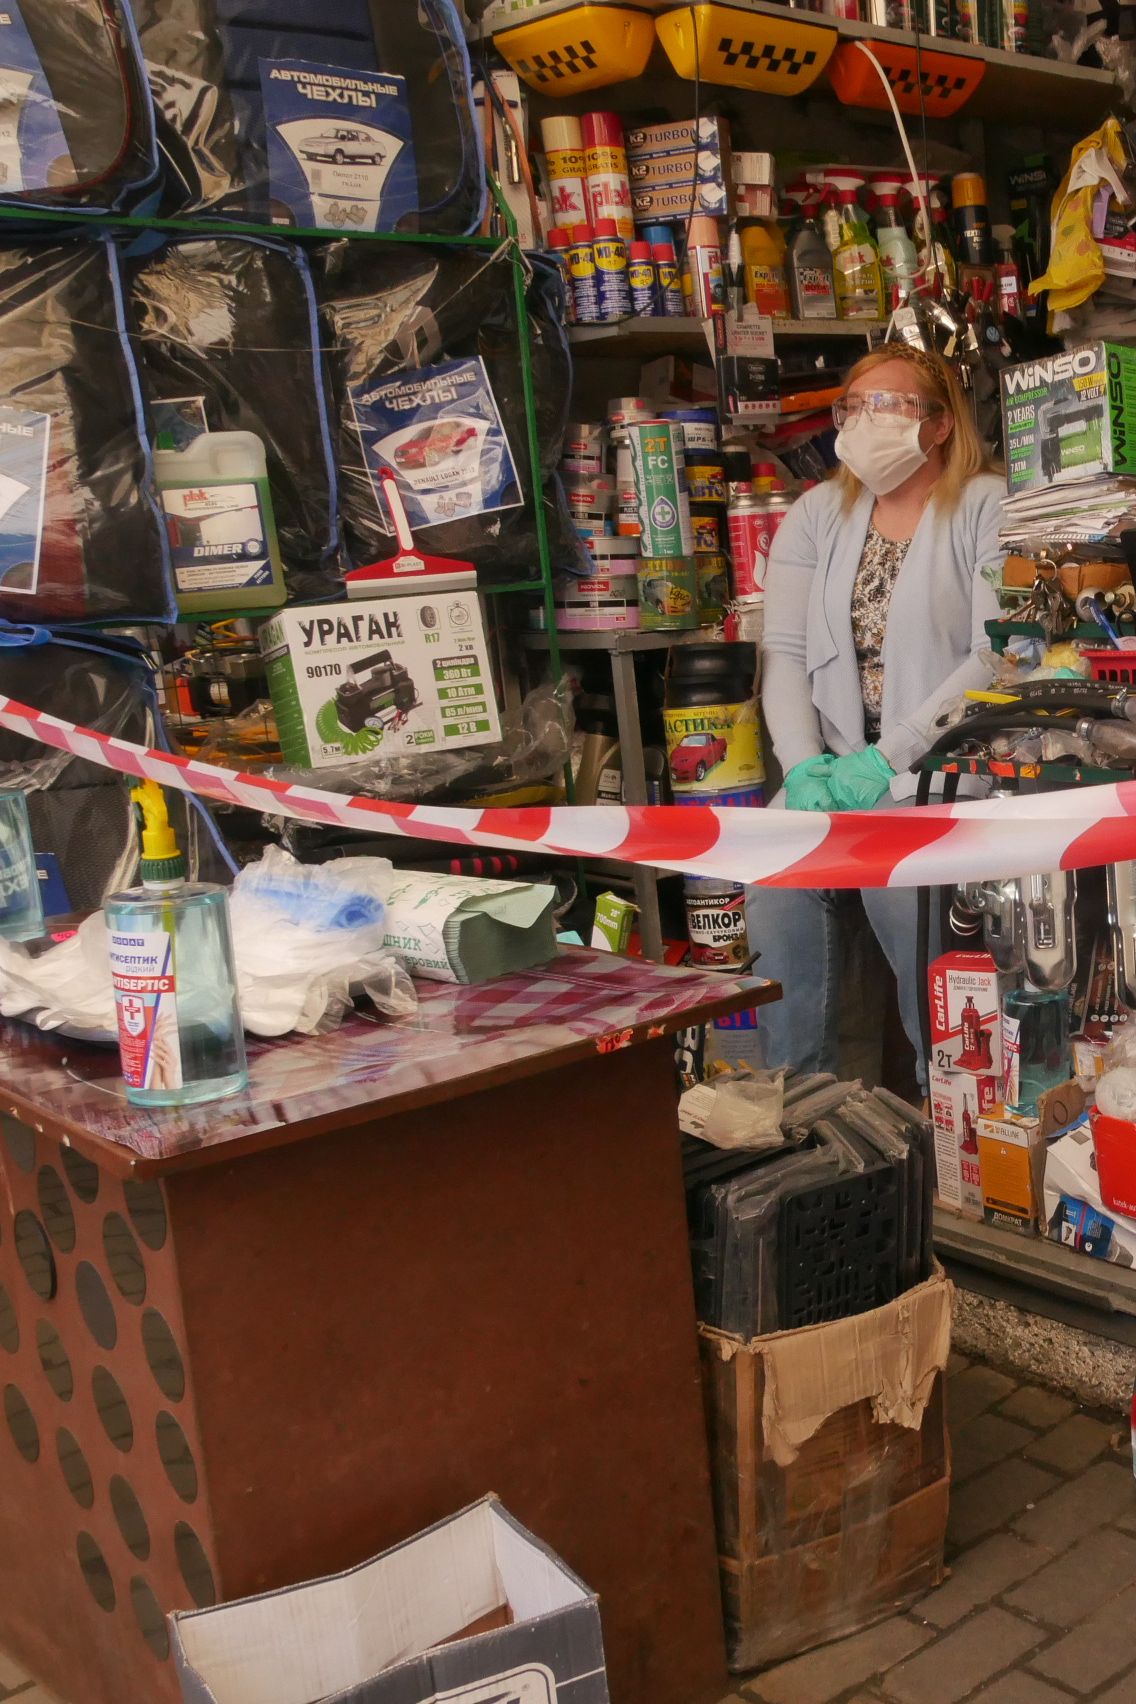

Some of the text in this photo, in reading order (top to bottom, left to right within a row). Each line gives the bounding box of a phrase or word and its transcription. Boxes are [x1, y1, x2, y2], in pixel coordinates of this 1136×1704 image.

[269, 68, 399, 97] АВТОМОБИЛЬНЫЕ
[296, 83, 377, 108] ЧЕХЛЫ
[629, 128, 688, 145] K2 TURBO
[632, 160, 693, 178] K2 TURBO
[635, 193, 696, 209] K2 TURBO
[1004, 350, 1096, 395] WiNSO
[358, 371, 478, 407] АВТОМОБИЛЬНЫЕ
[1087, 387, 1100, 399] VOLT
[384, 386, 460, 412] ЧЕХЛЫ
[1007, 404, 1035, 425] 2 YEARS
[642, 436, 668, 453] 2T
[648, 455, 669, 470] FC
[193, 542, 244, 558] DIMER
[297, 610, 403, 648] УРАГАН
[424, 632, 441, 644] R17
[306, 663, 342, 679] 90170
[446, 686, 457, 698] 10
[457, 723, 466, 734] 12
[406, 734, 415, 745] 2
[948, 974, 992, 986] Hydraulic Jack
[933, 975, 946, 1032] CarLife
[931, 1075, 952, 1086] CarLife
[993, 1211, 1022, 1226] ДОМКРАТ
